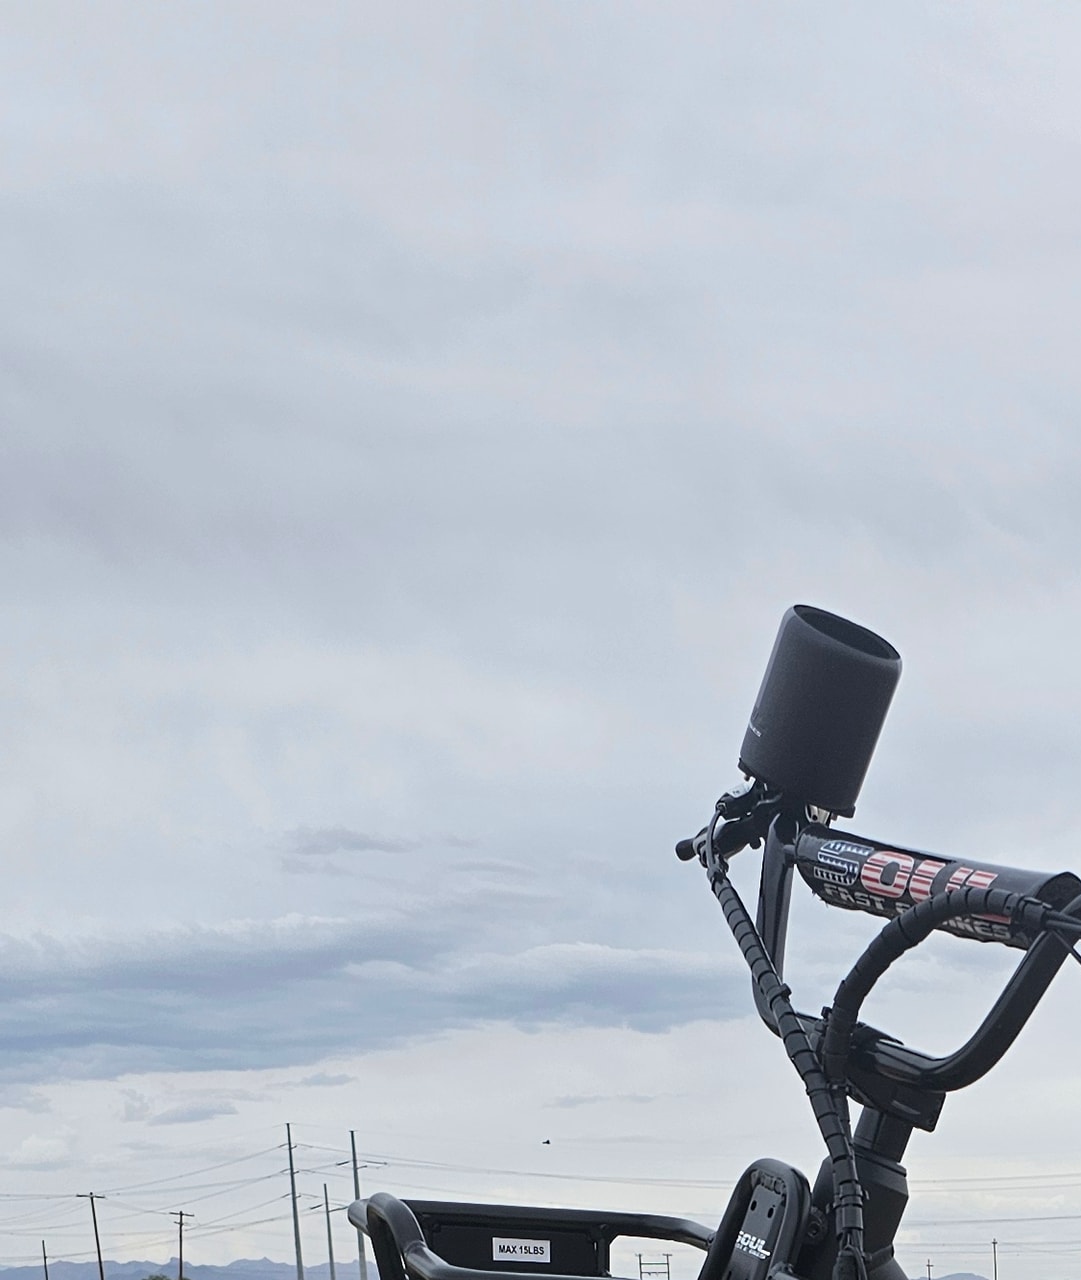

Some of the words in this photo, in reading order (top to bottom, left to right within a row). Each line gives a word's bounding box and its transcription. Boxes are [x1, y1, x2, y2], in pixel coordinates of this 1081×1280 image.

[823, 883, 885, 911] FAST
[498, 1244, 517, 1255] MAX
[519, 1245, 545, 1256] 15LBS
